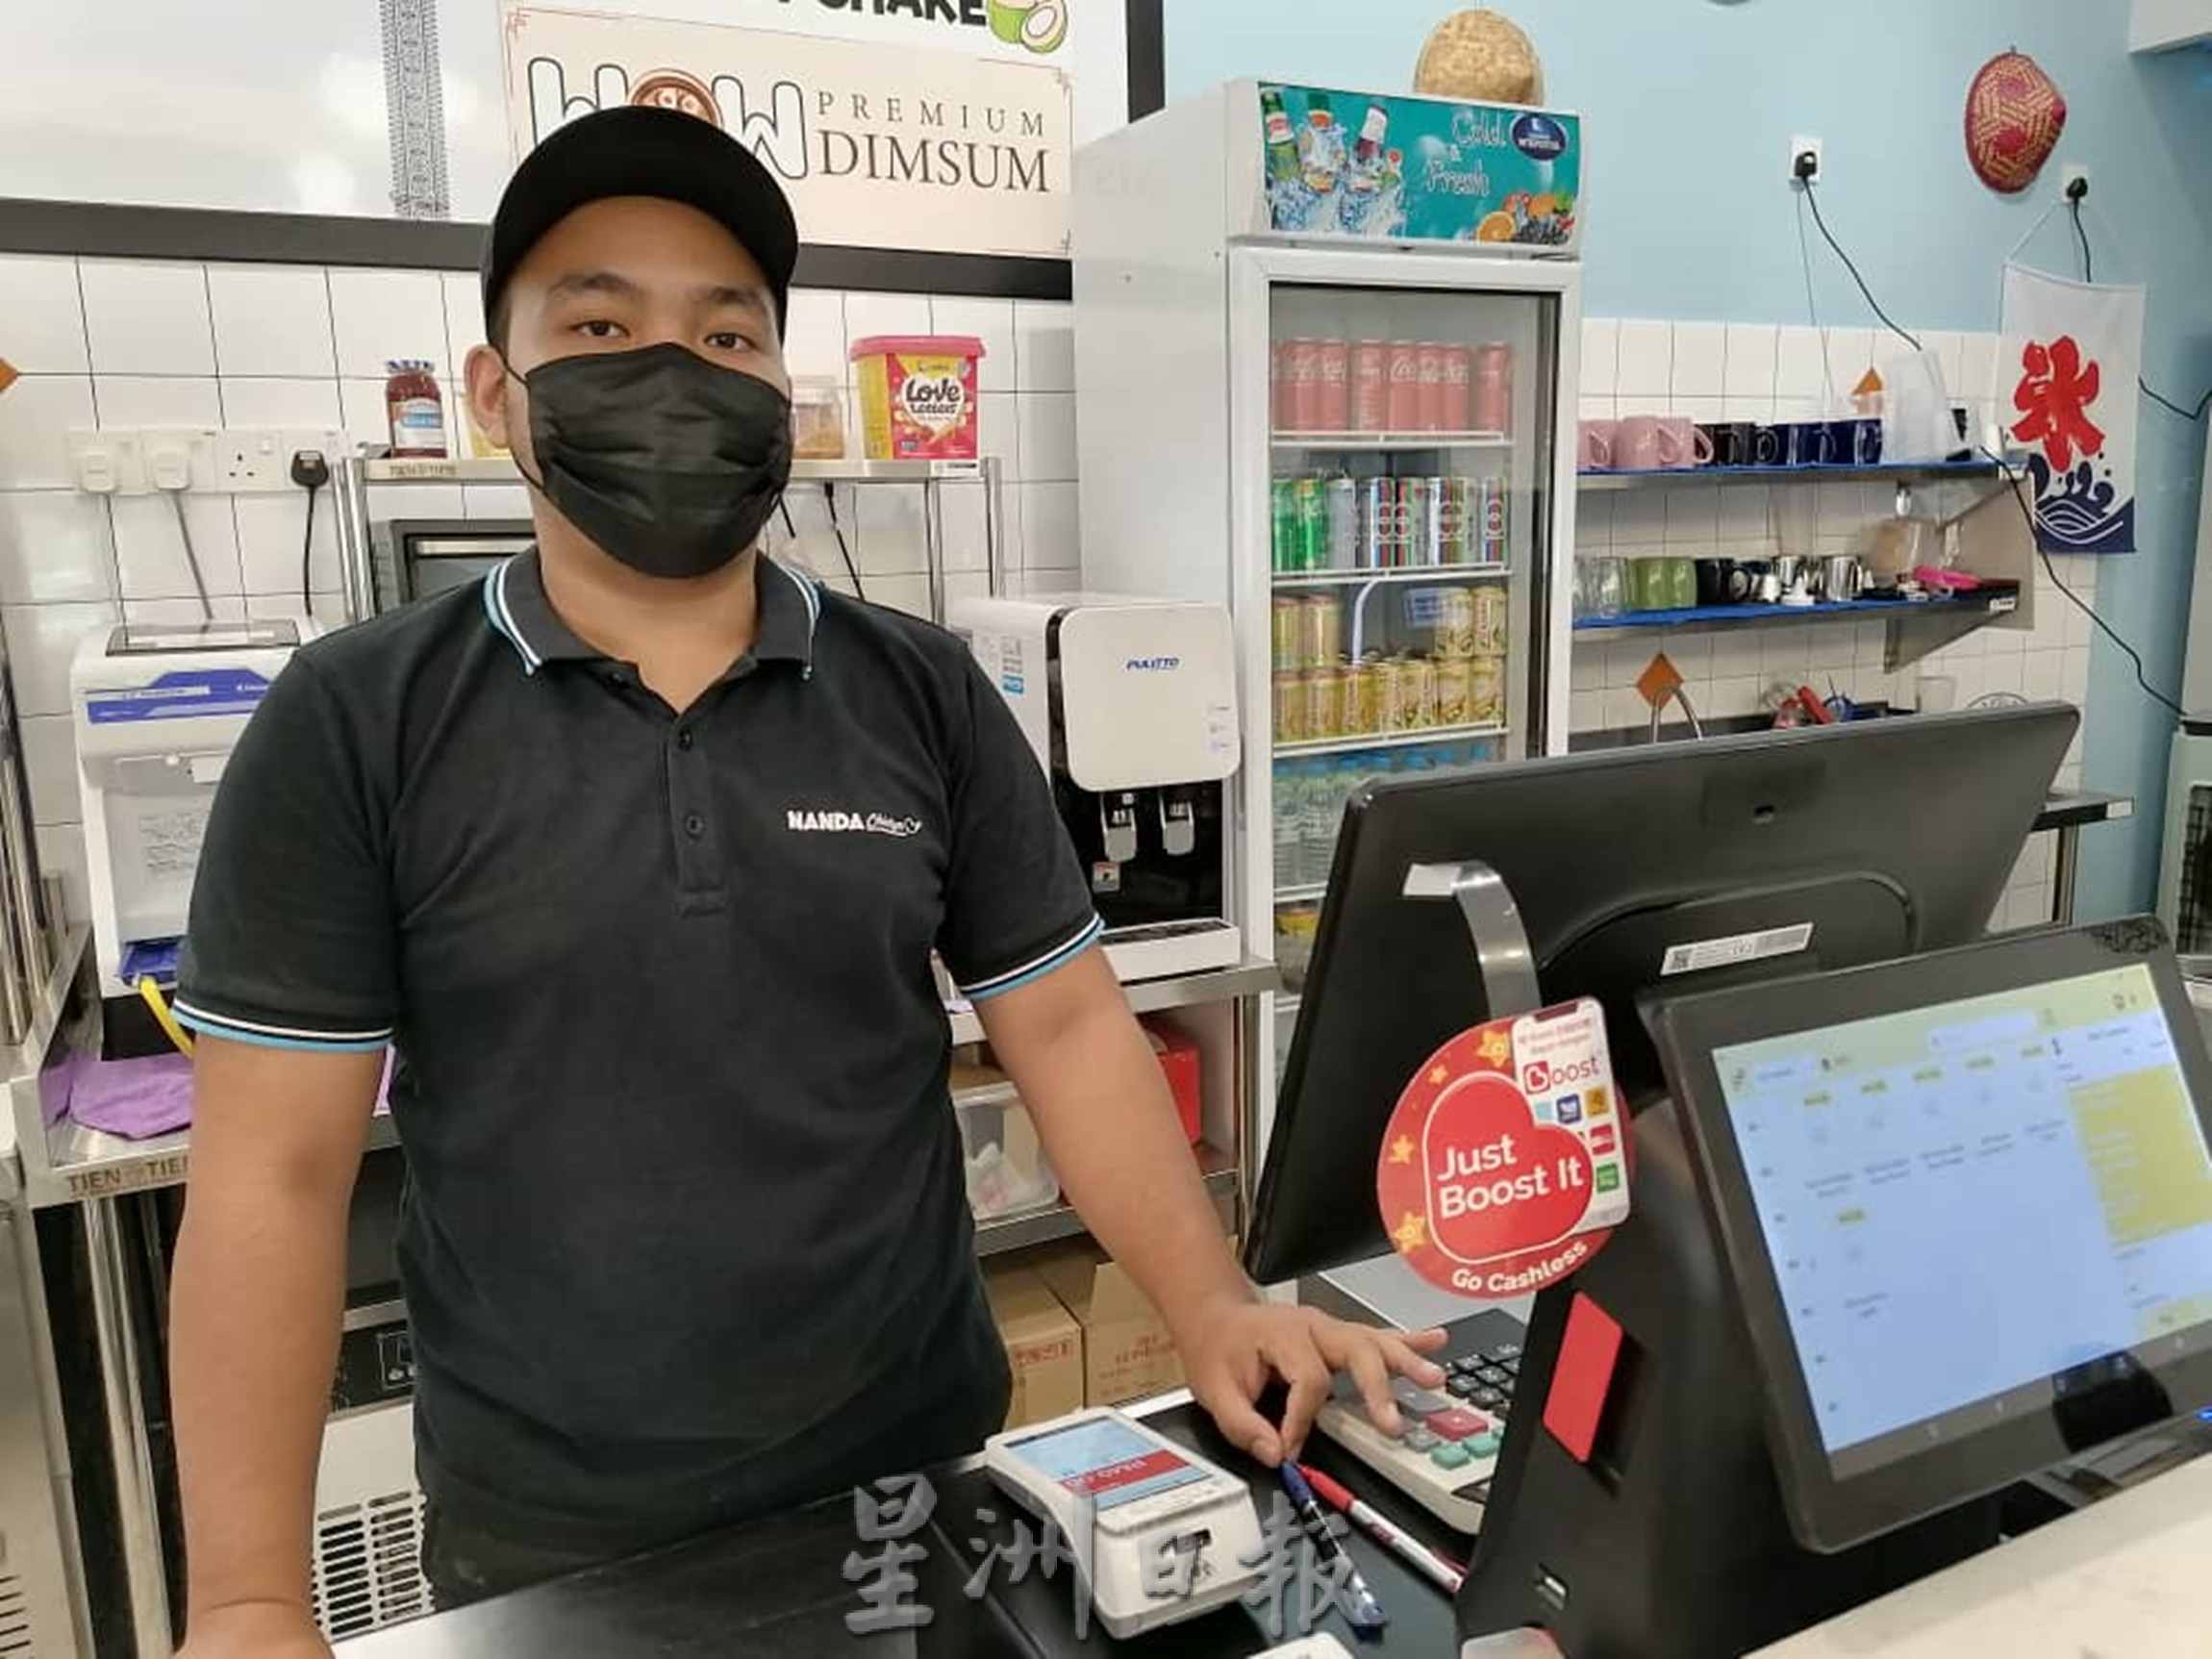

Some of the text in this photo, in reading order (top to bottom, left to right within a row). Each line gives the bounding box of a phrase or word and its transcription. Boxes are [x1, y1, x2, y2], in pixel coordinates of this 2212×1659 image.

[817, 91, 1045, 137] PREMIUM
[819, 131, 1049, 192] DIMSUM
[906, 378, 961, 402] Love
[788, 810, 864, 830] NANDA
[64, 1168, 120, 1192] TIEN
[1438, 1134, 1517, 1180] Just
[1440, 1158, 1584, 1219] Boost It
[1452, 1242, 1587, 1292] Go Cashless
